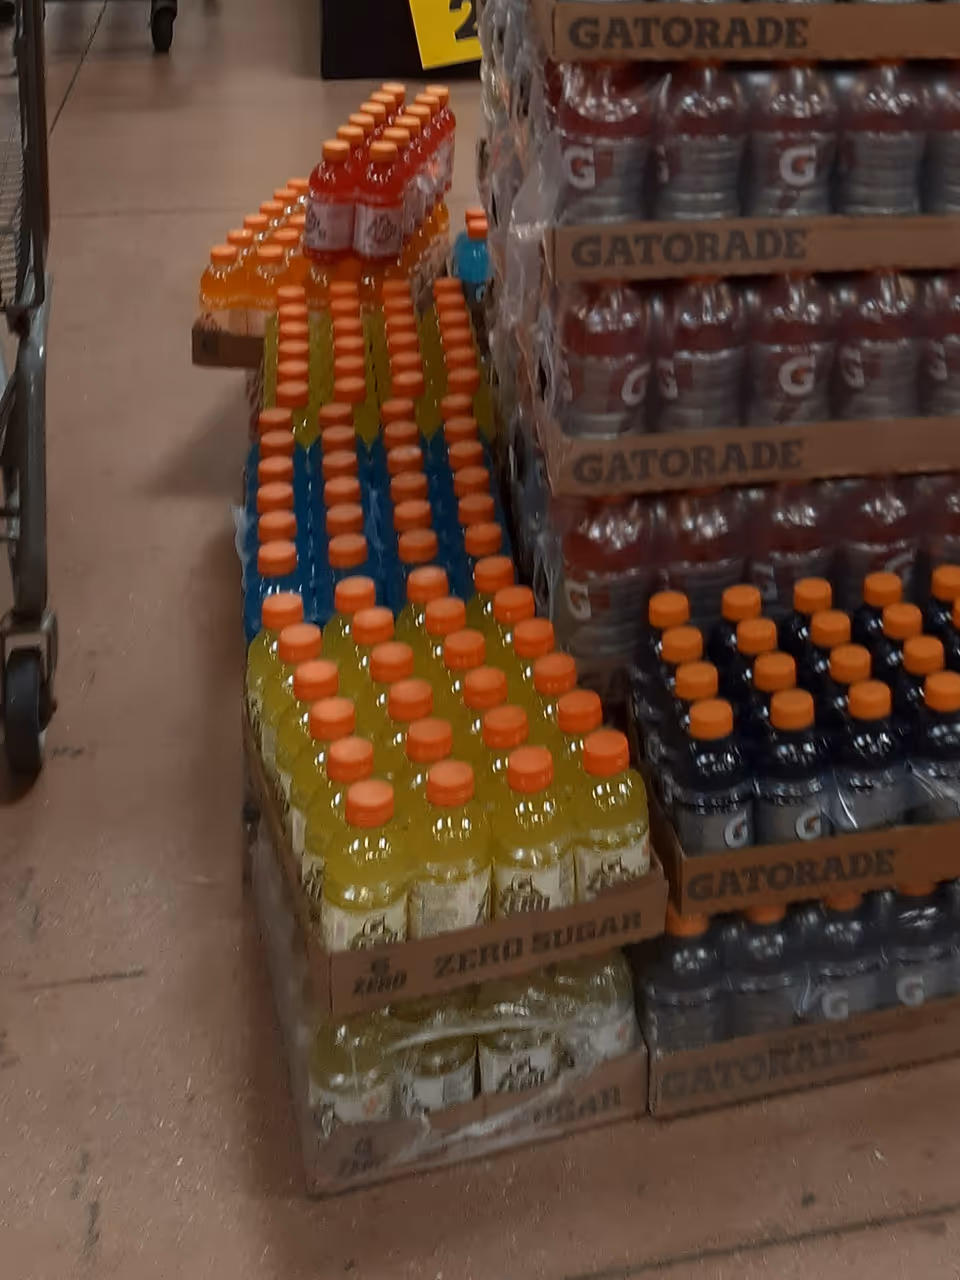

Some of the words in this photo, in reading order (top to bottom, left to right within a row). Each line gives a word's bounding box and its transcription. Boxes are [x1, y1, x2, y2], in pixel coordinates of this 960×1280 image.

[569, 17, 810, 51] GATORADE
[779, 147, 816, 186] G
[570, 228, 807, 268] GATORADE
[778, 356, 815, 396] G
[573, 438, 804, 484] GATORADE
[686, 849, 896, 902] GATORADE
[434, 937, 524, 980] ZERO
[532, 912, 643, 947] SUGAR
[661, 1034, 871, 1098] GATORADE
